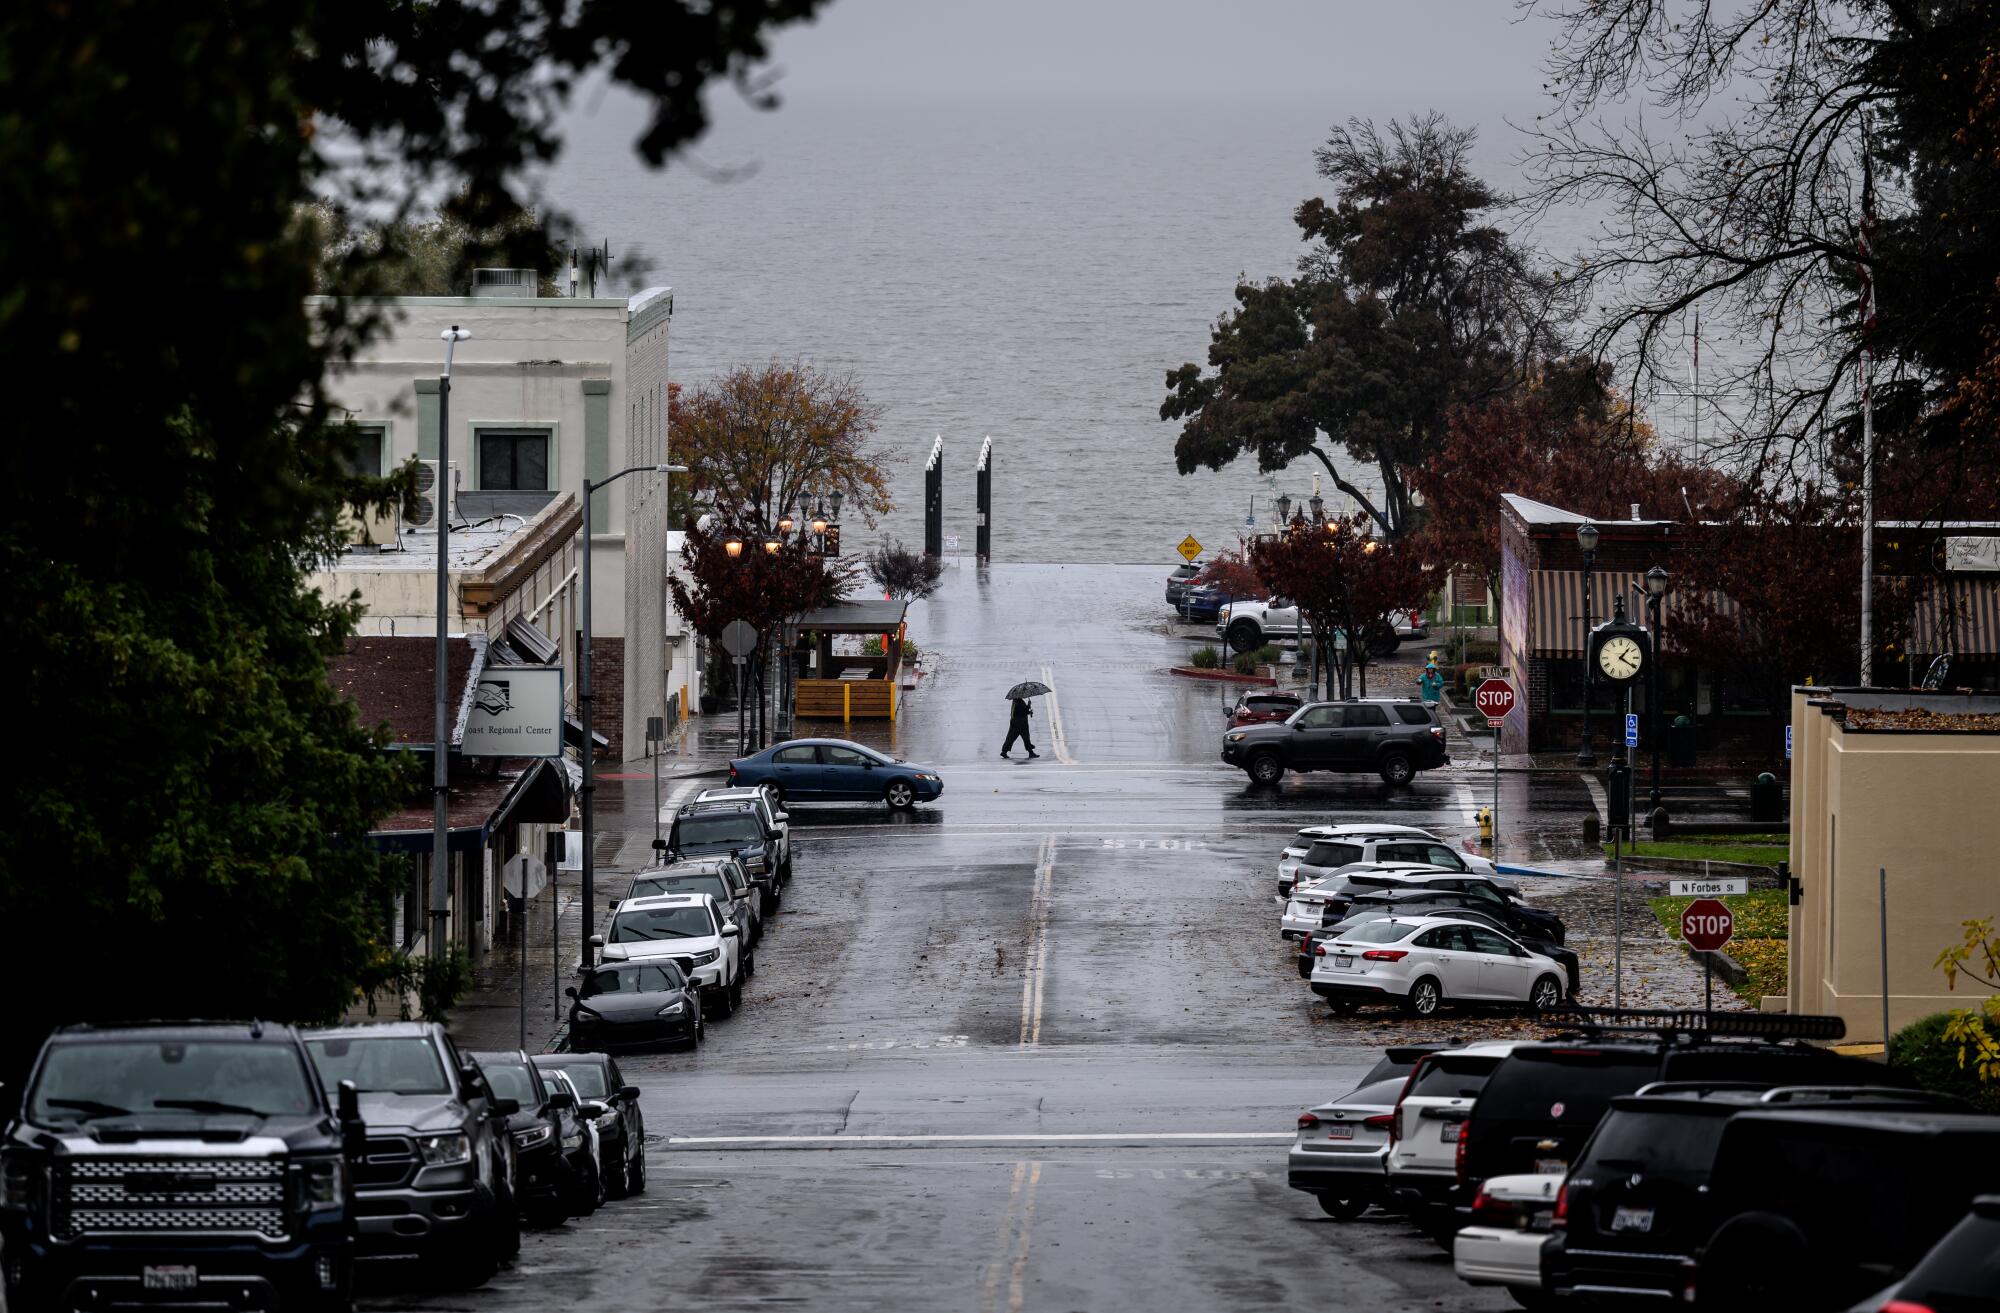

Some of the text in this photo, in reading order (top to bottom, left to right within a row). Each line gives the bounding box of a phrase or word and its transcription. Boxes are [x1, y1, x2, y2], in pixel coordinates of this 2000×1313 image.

[1486, 667, 1503, 677] MAIN
[1479, 691, 1513, 706] STOP
[468, 725, 553, 736] oast Regional Center
[1681, 882, 1735, 893] N Forbes St
[1685, 915, 1731, 935] STOP
